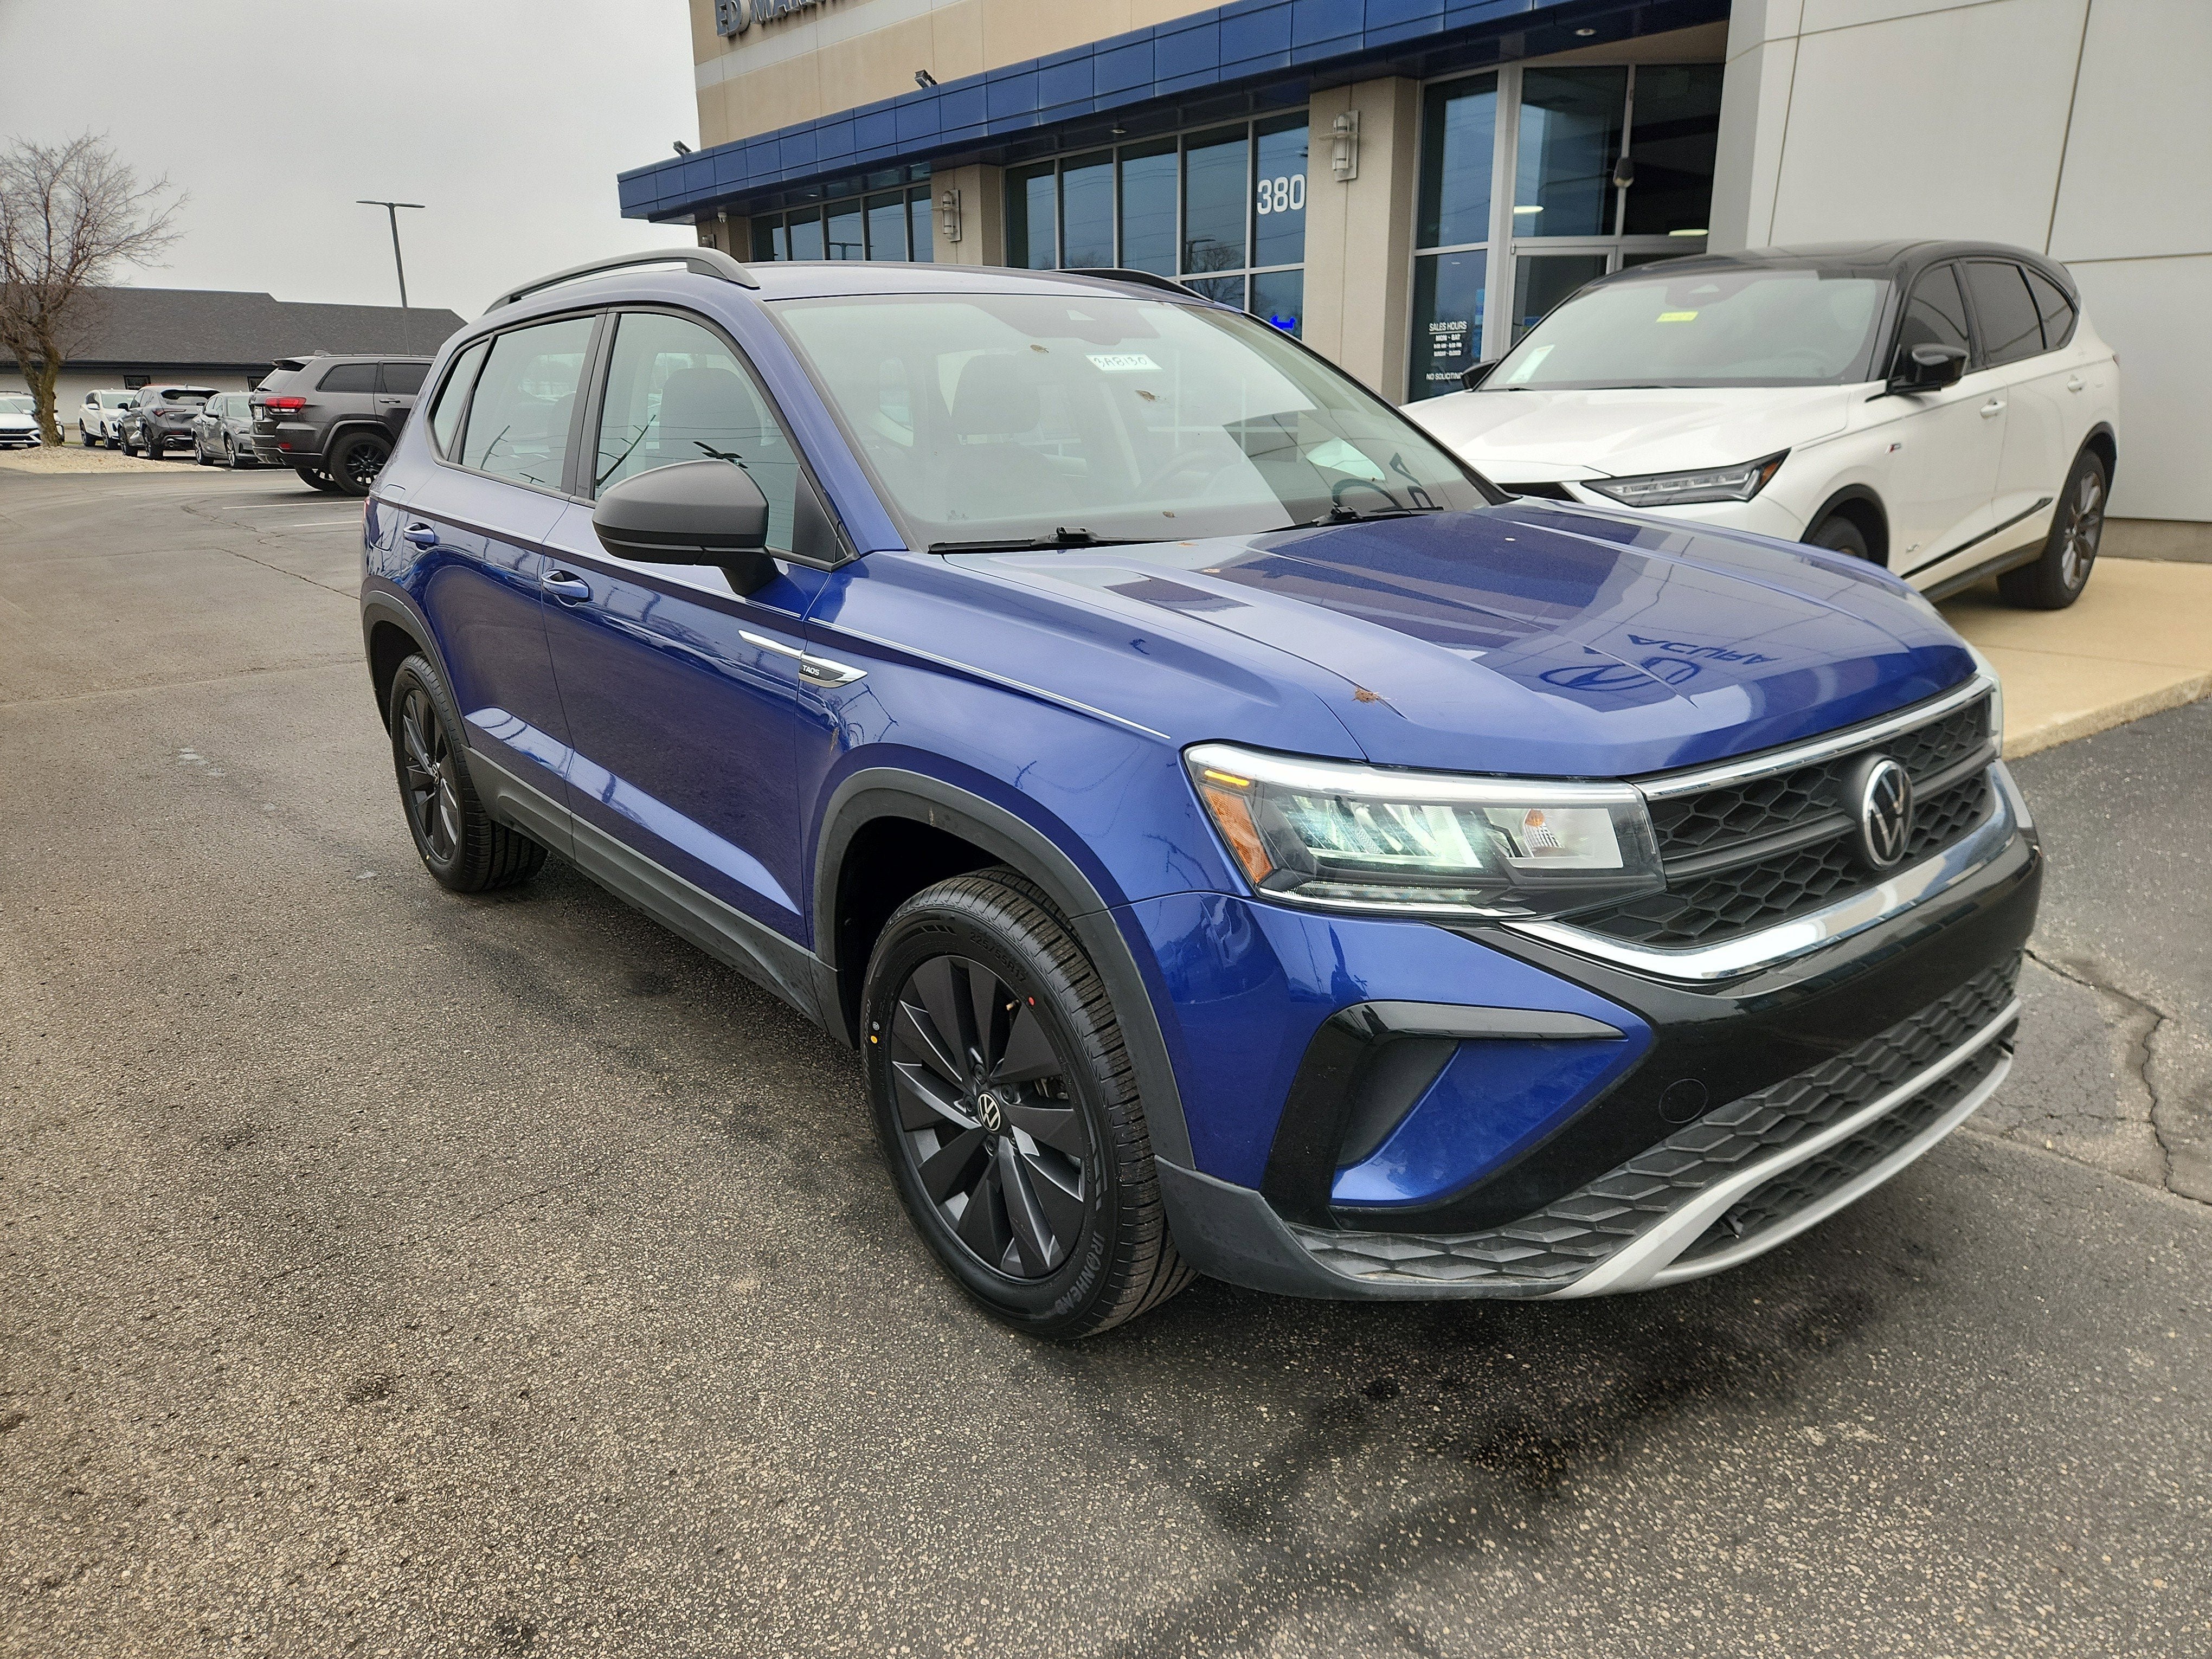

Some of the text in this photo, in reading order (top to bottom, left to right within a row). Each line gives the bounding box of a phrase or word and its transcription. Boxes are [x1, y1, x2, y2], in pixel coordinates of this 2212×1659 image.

[1257, 174, 1306, 214] 380
[1429, 321, 1467, 331] SALES HOURS
[802, 665, 820, 676] TAOS
